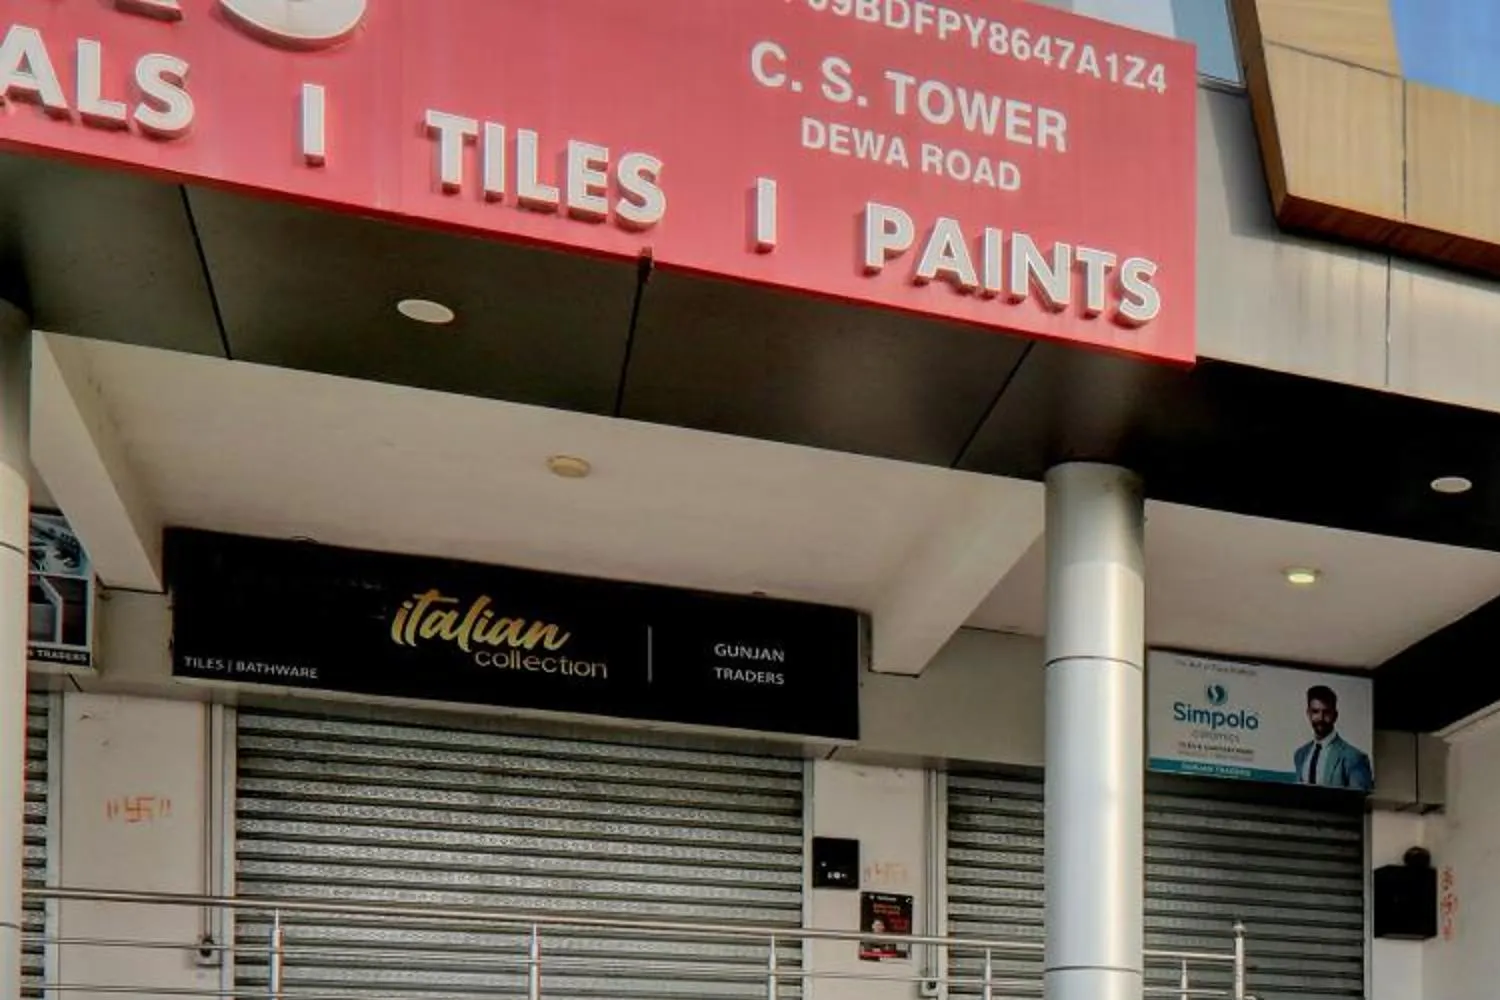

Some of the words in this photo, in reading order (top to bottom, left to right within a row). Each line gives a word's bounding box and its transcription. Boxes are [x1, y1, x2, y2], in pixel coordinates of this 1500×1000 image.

[884, 70, 1068, 152] TOWER
[801, 116, 909, 167] DEWA
[920, 143, 1021, 191] ROAD
[424, 108, 667, 228] TILES
[864, 200, 1161, 326] PAINTS
[390, 588, 571, 653] italian
[184, 655, 225, 672] TILES
[236, 660, 318, 680] BATHWARE
[474, 649, 608, 679] collection
[713, 642, 785, 663] GUNJAN
[713, 666, 785, 686] TRADERS
[1173, 701, 1259, 730] Simpolo
